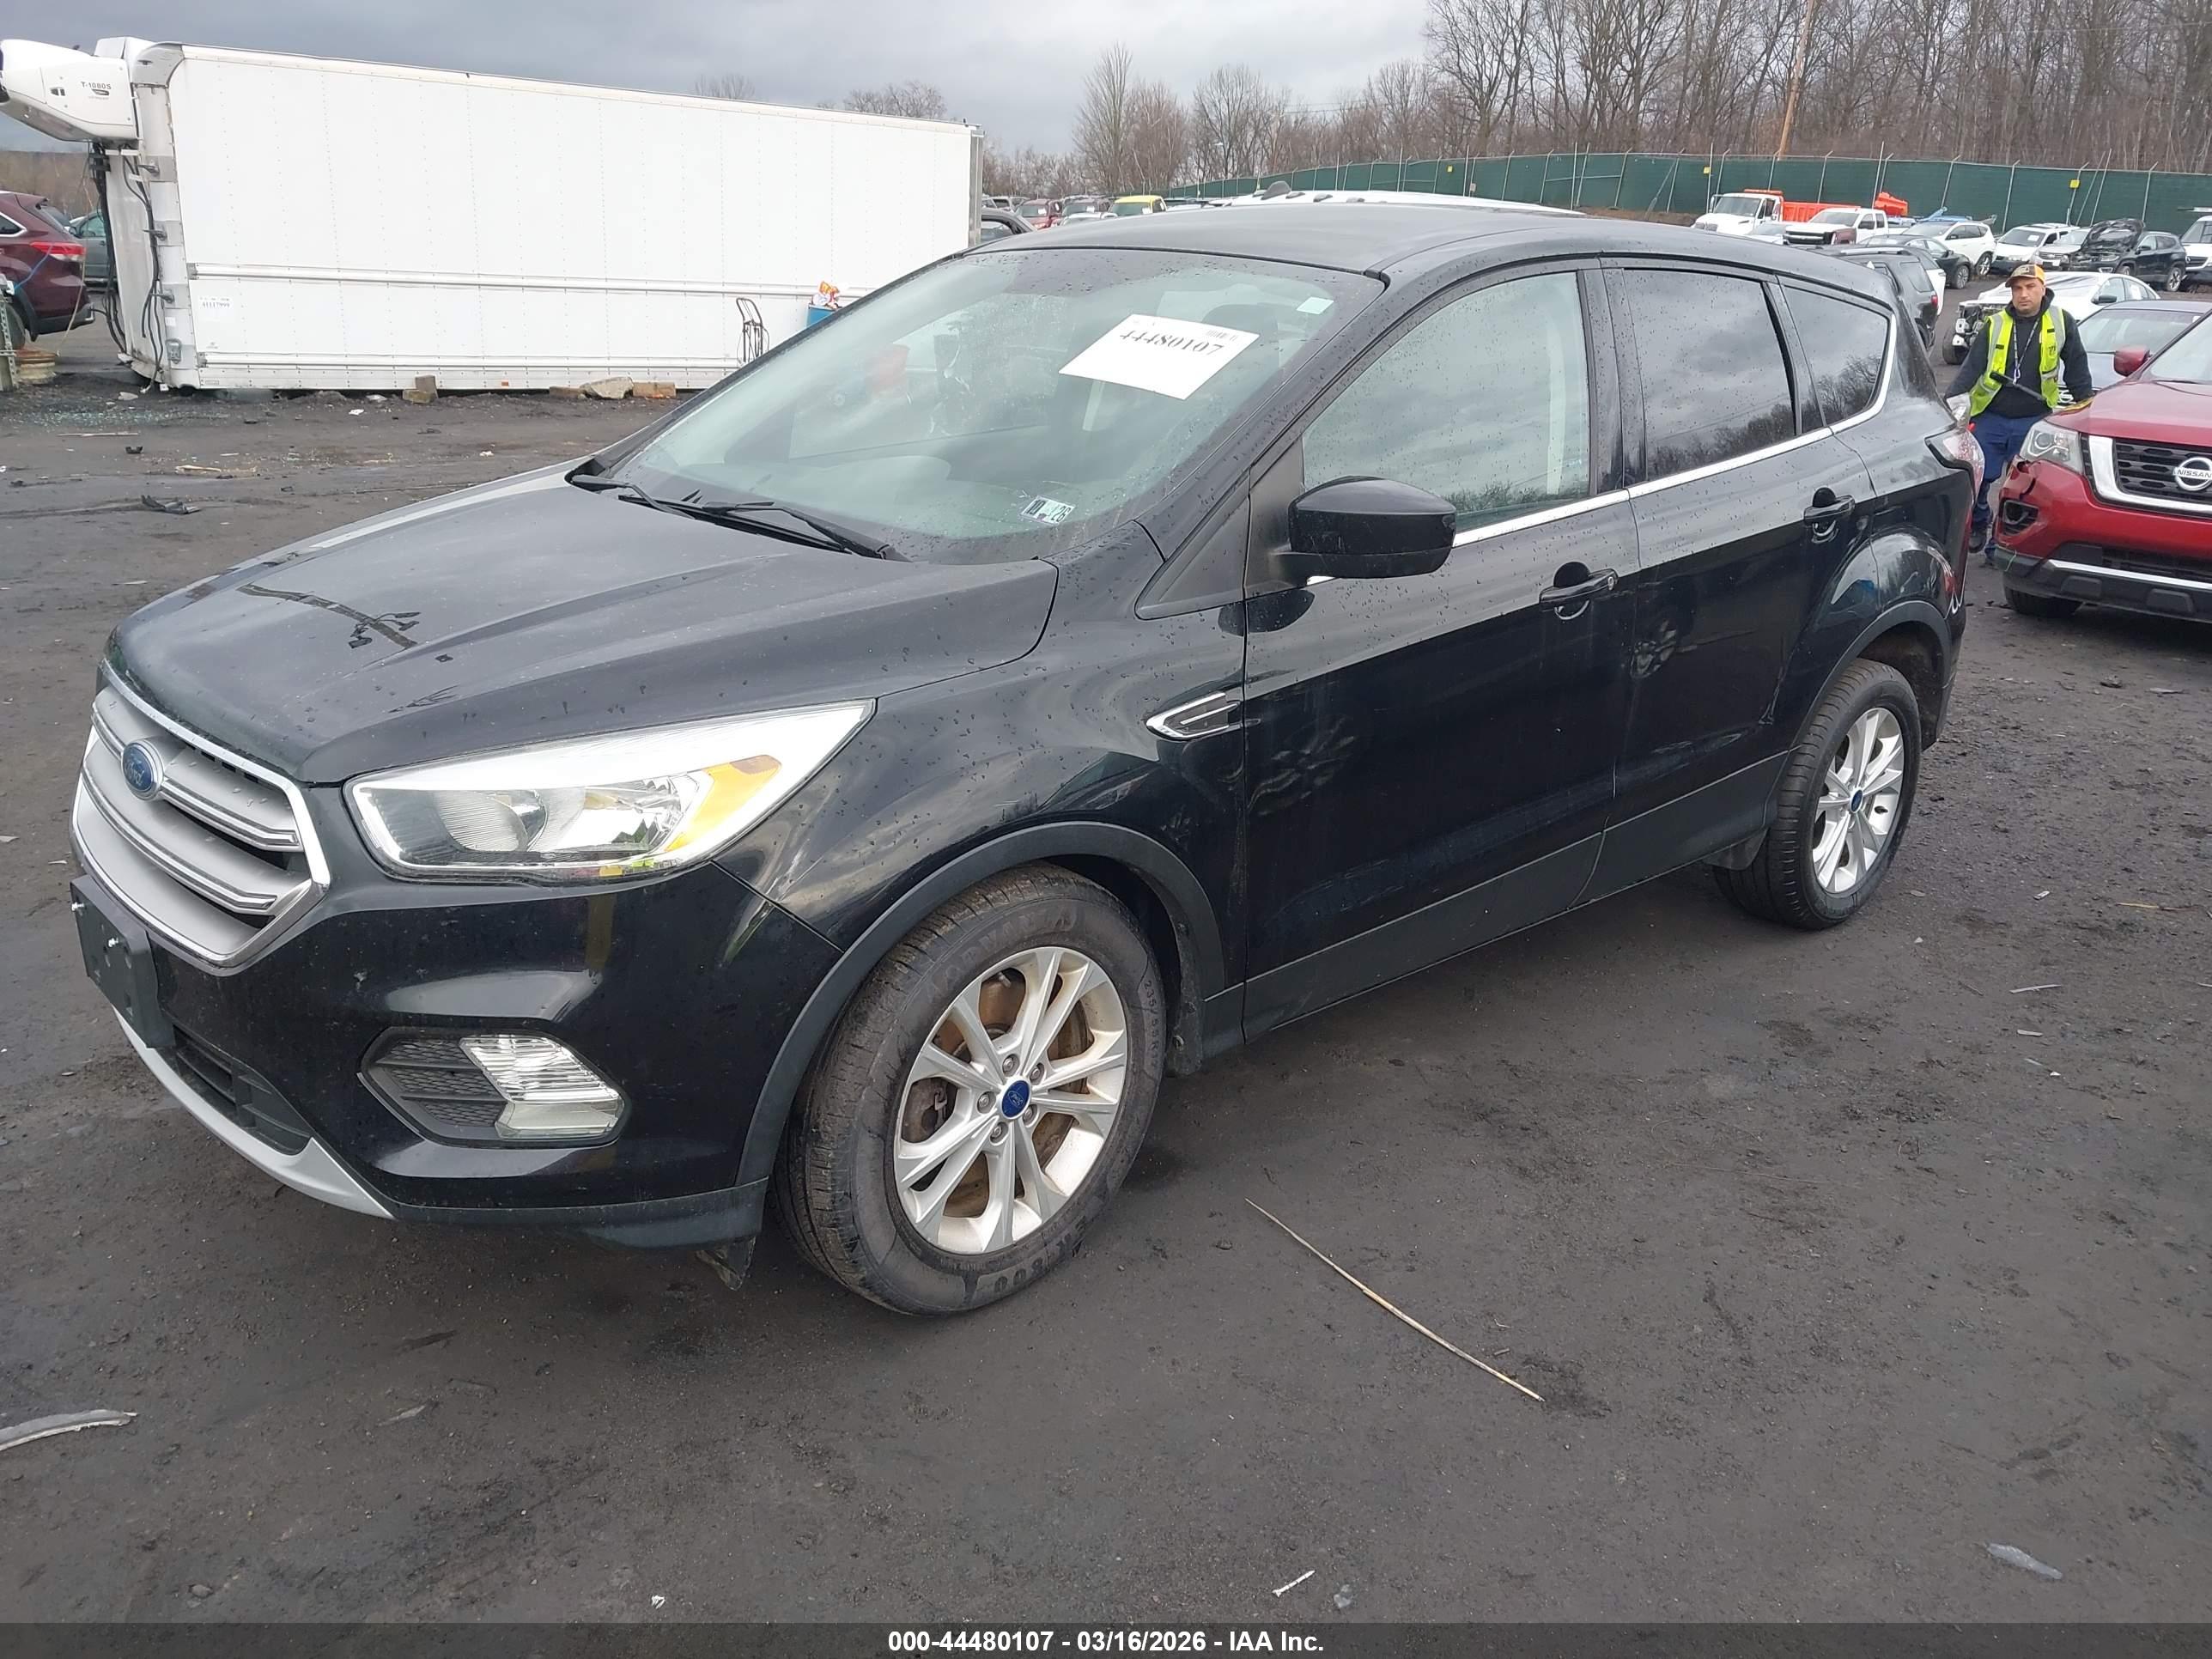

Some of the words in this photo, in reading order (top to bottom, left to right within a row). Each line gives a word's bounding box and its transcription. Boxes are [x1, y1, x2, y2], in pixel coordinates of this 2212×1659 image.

[1120, 331, 1224, 355] 44480107
[2177, 469, 2212, 478] NISSAN
[1051, 506, 1072, 522] 26
